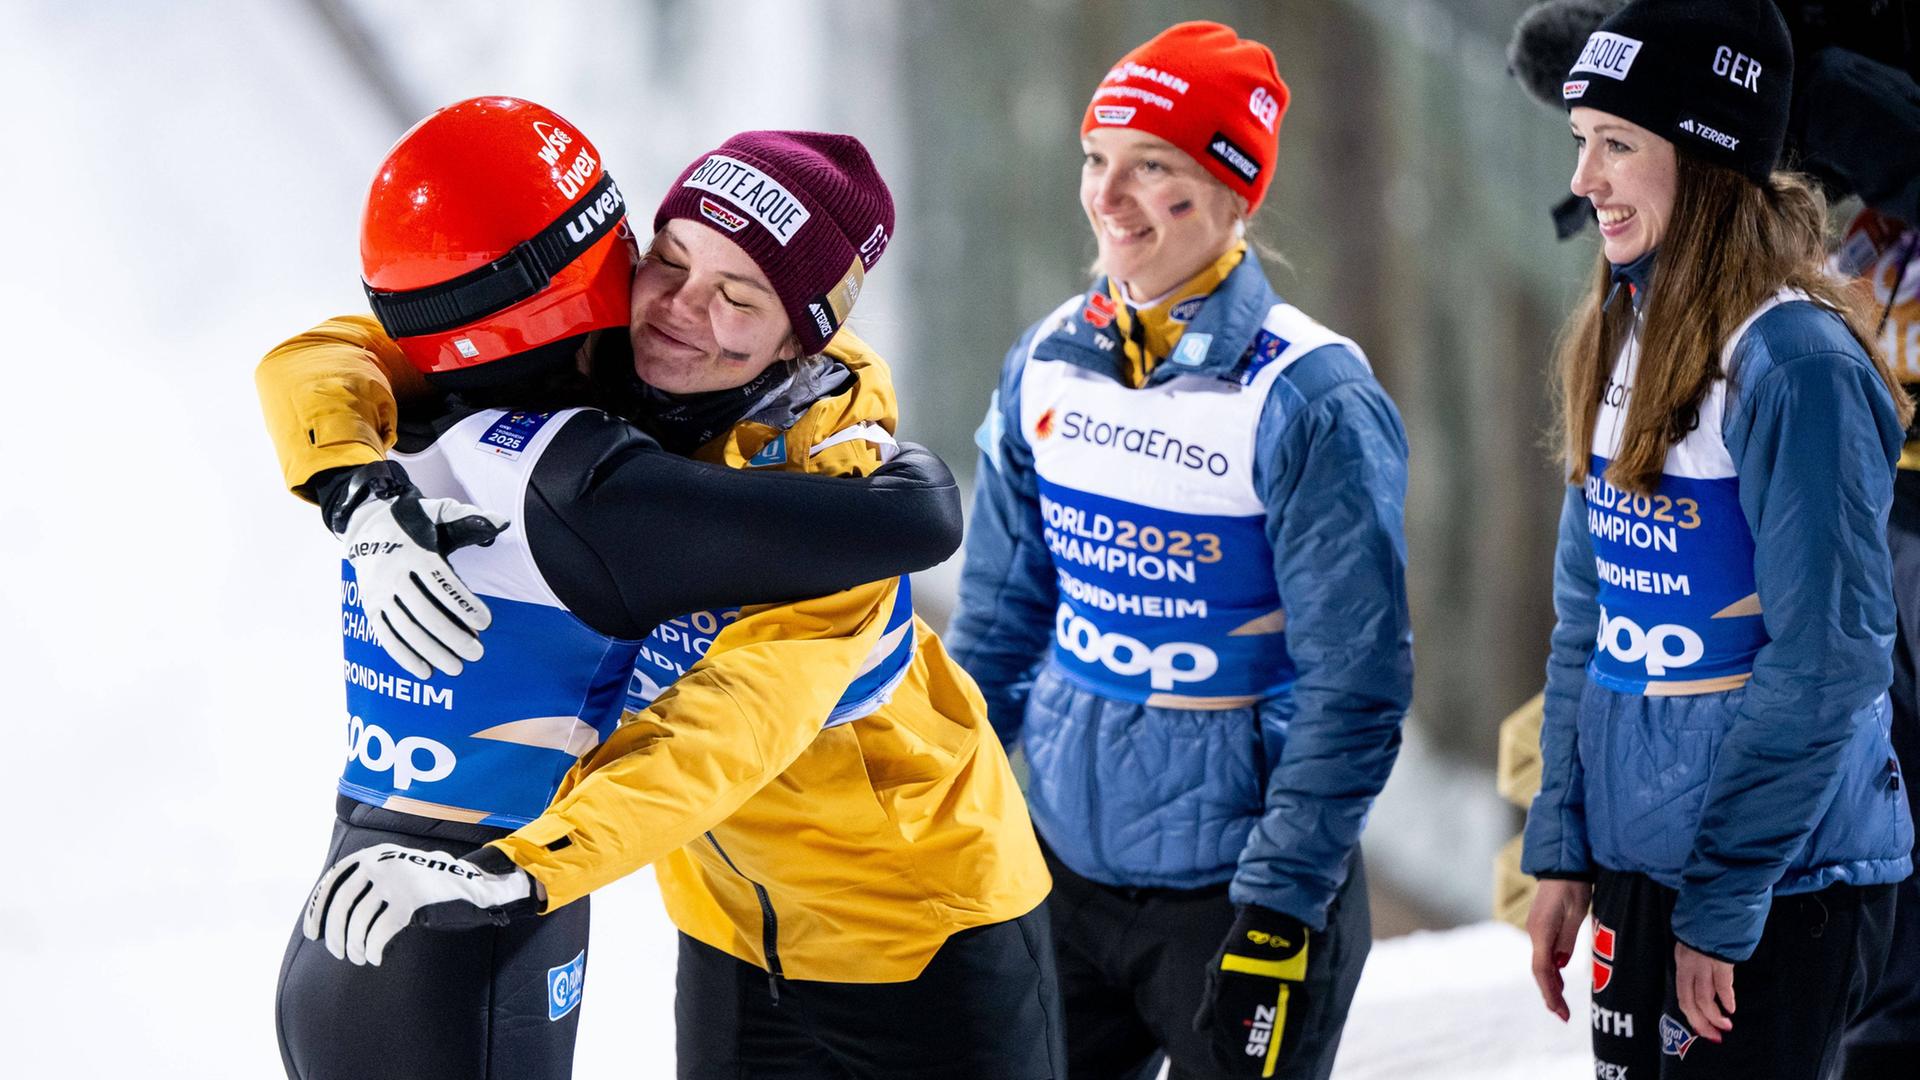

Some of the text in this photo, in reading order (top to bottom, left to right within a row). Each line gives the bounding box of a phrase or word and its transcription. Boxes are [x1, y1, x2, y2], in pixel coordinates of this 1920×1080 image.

[1712, 45, 1762, 93] GER
[1249, 86, 1279, 135] GER
[1697, 123, 1740, 151] TERREX
[556, 146, 597, 200] uvex
[692, 158, 802, 237] BIOTEAQUE
[565, 182, 622, 243] uvex
[488, 432, 522, 449] 2025
[1062, 412, 1229, 477] StoraEnso
[1044, 527, 1197, 584] CHAMPION
[1115, 520, 1223, 563] 2023
[430, 569, 478, 614] ziener
[1056, 602, 1219, 691] coop
[344, 659, 453, 710] RONDHEIM
[377, 849, 482, 880] ziener
[1245, 1004, 1277, 1057] SEIZ
[1592, 1001, 1634, 1038] RTH
